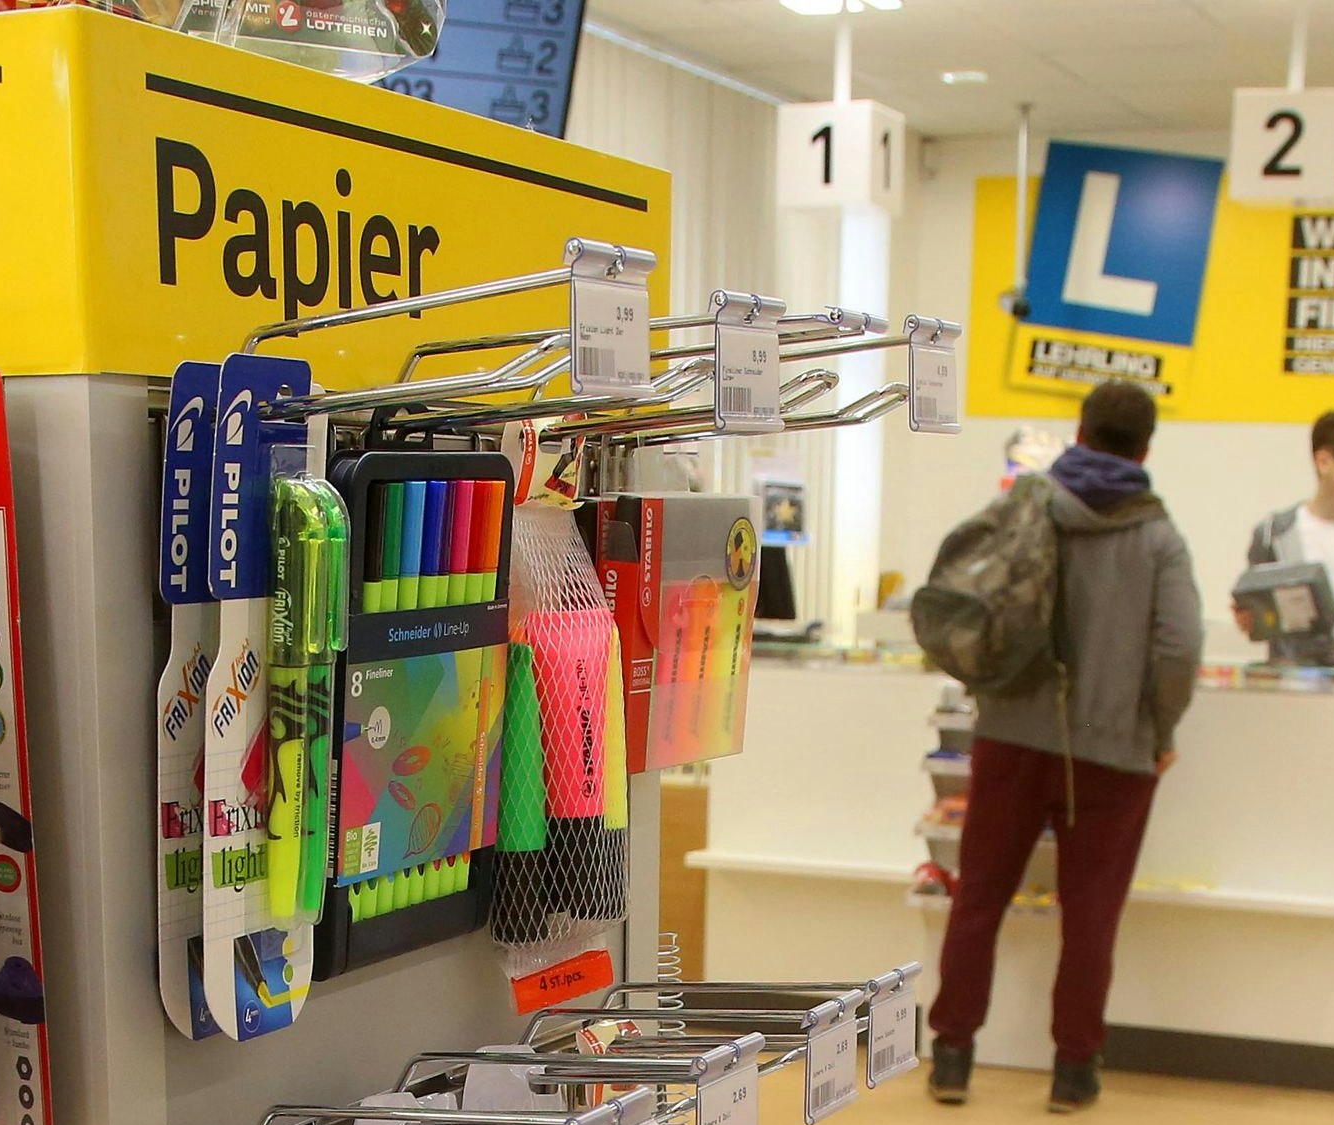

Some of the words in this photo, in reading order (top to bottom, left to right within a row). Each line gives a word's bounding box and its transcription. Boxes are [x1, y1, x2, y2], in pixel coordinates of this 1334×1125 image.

[306, 18, 387, 38] LOTTERIEN
[538, 40, 558, 76] 2
[532, 90, 551, 125] 3
[811, 124, 834, 186] 1
[1262, 109, 1305, 177] 2
[154, 168, 441, 323] Papier
[1061, 171, 1158, 316] L
[616, 306, 634, 322] 3,99
[170, 468, 193, 594] PILOT
[218, 461, 242, 590] PILOT
[276, 543, 287, 581] PILOT
[644, 507, 654, 584] STABILO
[387, 624, 432, 644] Schneider
[443, 621, 470, 639] Line-Up
[350, 670, 364, 698] 8
[365, 665, 395, 681] Fineliner
[294, 752, 303, 780] remove
[293, 796, 303, 838] friction
[220, 839, 267, 892] light
[540, 975, 549, 992] 4
[836, 1039, 848, 1055] 2,69
[732, 1087, 747, 1104] 2,69
